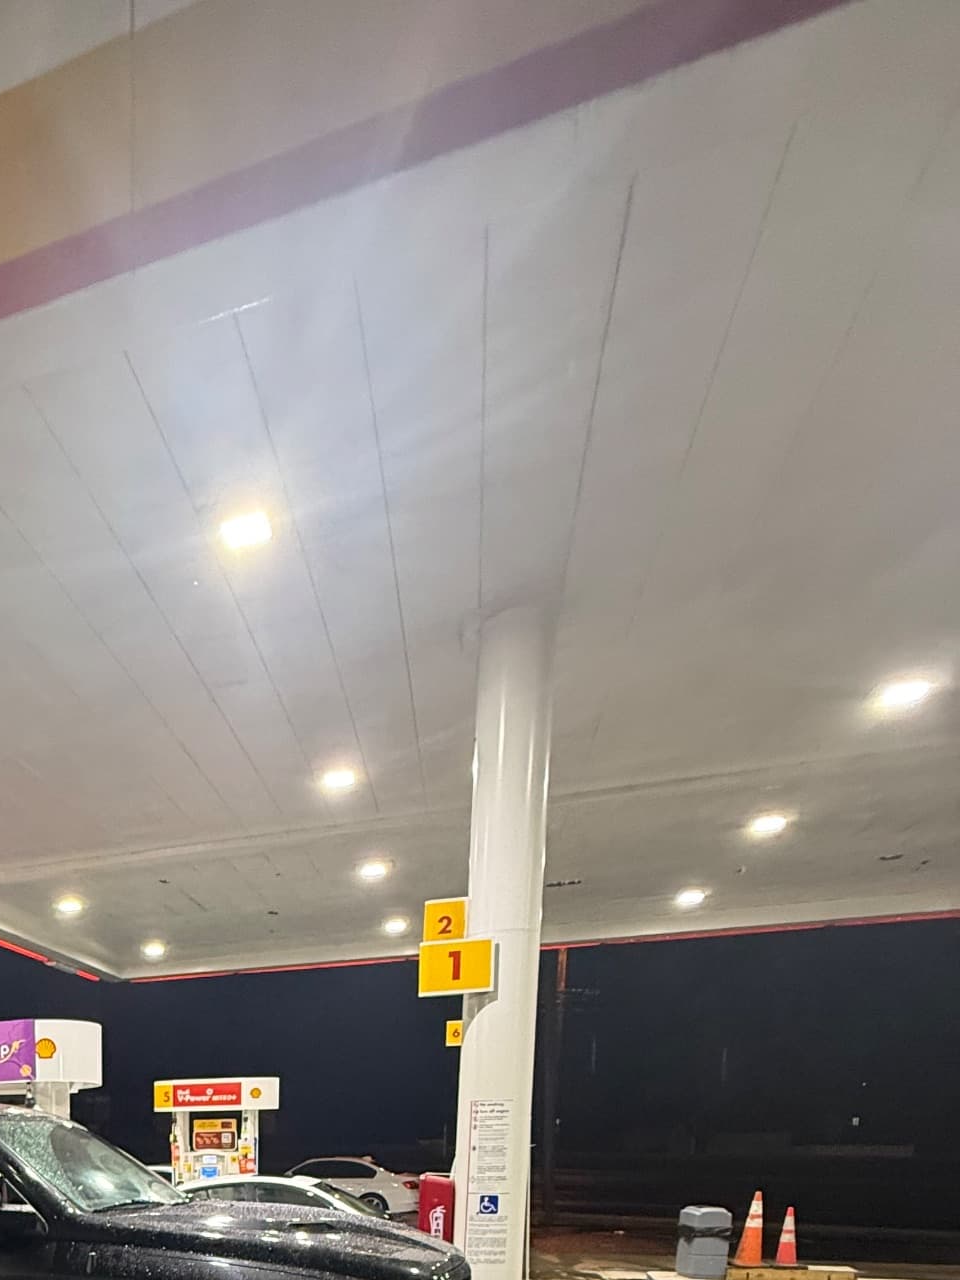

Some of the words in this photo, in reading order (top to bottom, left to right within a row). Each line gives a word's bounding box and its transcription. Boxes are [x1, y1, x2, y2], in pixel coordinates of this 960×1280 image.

[437, 915, 453, 935] 2
[448, 950, 462, 981] 1
[452, 1028, 461, 1038] 6
